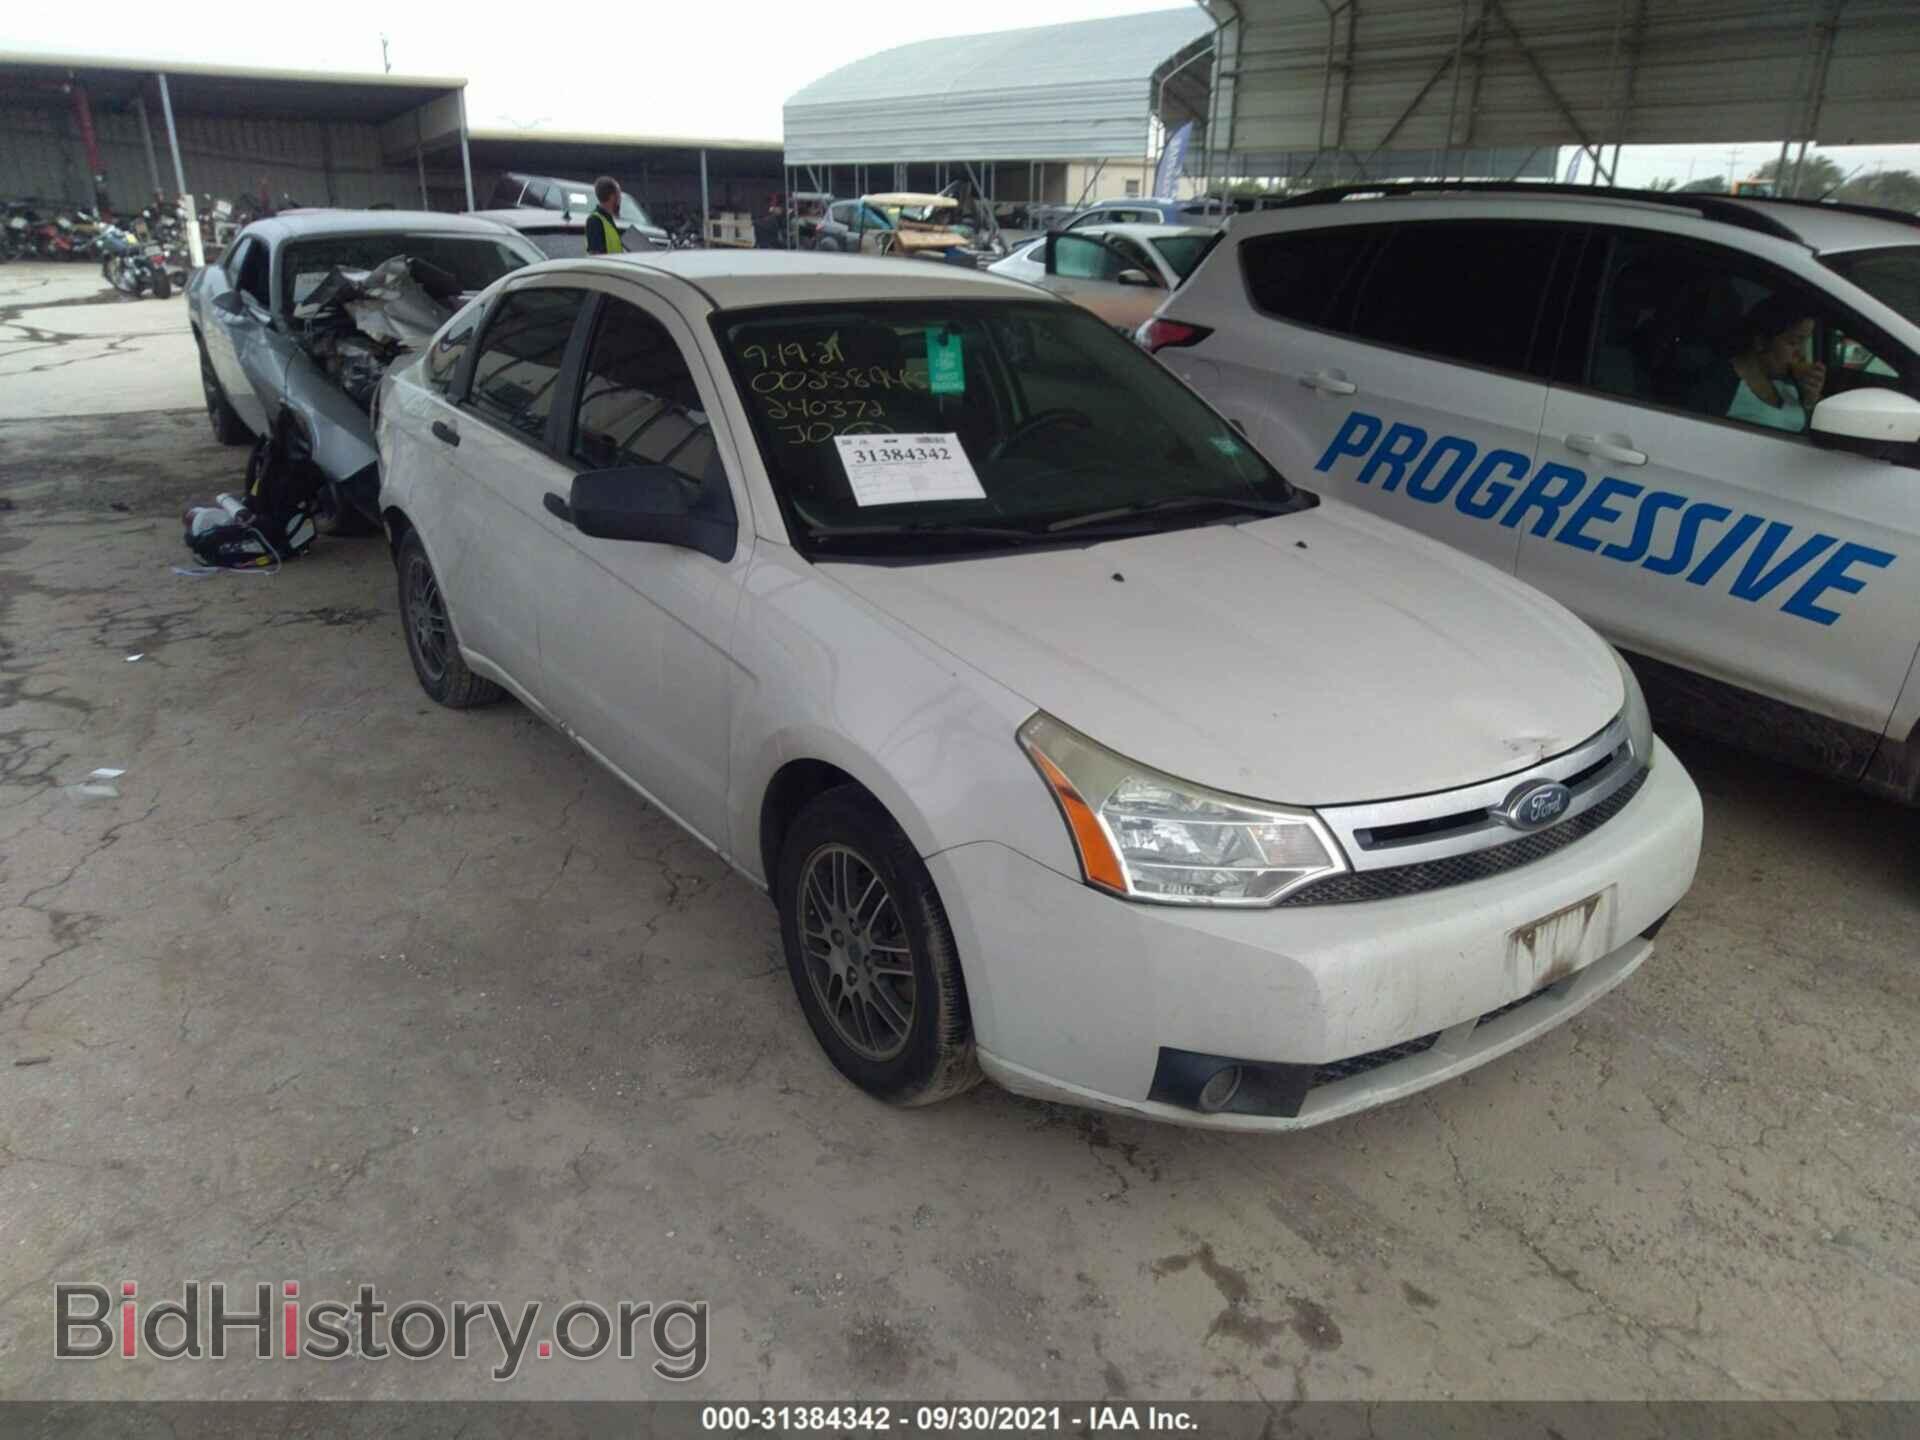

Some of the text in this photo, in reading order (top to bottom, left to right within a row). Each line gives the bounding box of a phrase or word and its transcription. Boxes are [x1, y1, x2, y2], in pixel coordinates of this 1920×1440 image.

[854, 447, 952, 464] 31384342
[1314, 411, 1896, 626] PROGRESSIVE
[1530, 791, 1562, 822] Ford
